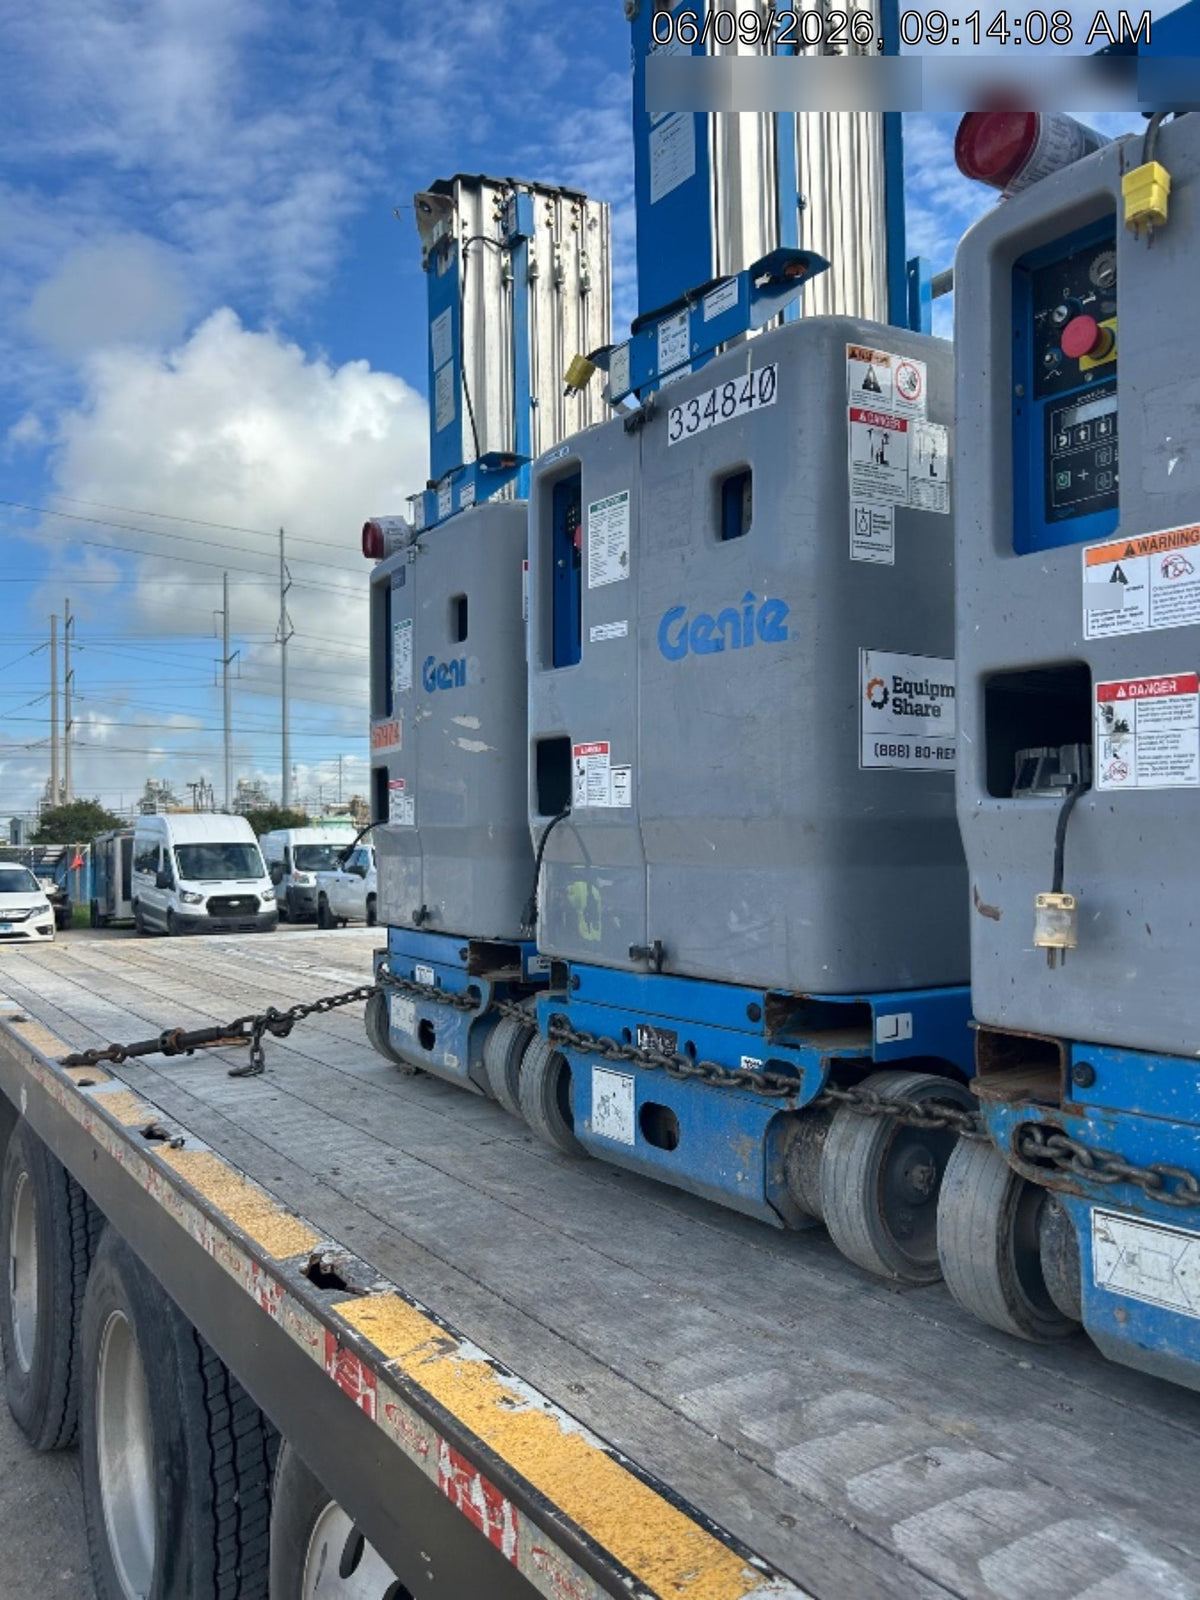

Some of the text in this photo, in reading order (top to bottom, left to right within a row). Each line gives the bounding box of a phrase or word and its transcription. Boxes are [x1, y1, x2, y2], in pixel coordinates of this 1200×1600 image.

[669, 365, 776, 441] 334840
[1137, 529, 1200, 553] WARNING
[657, 590, 790, 661] Genie
[1128, 680, 1177, 697] DANGER
[892, 697, 942, 717] Share
[874, 742, 910, 759] (888)
